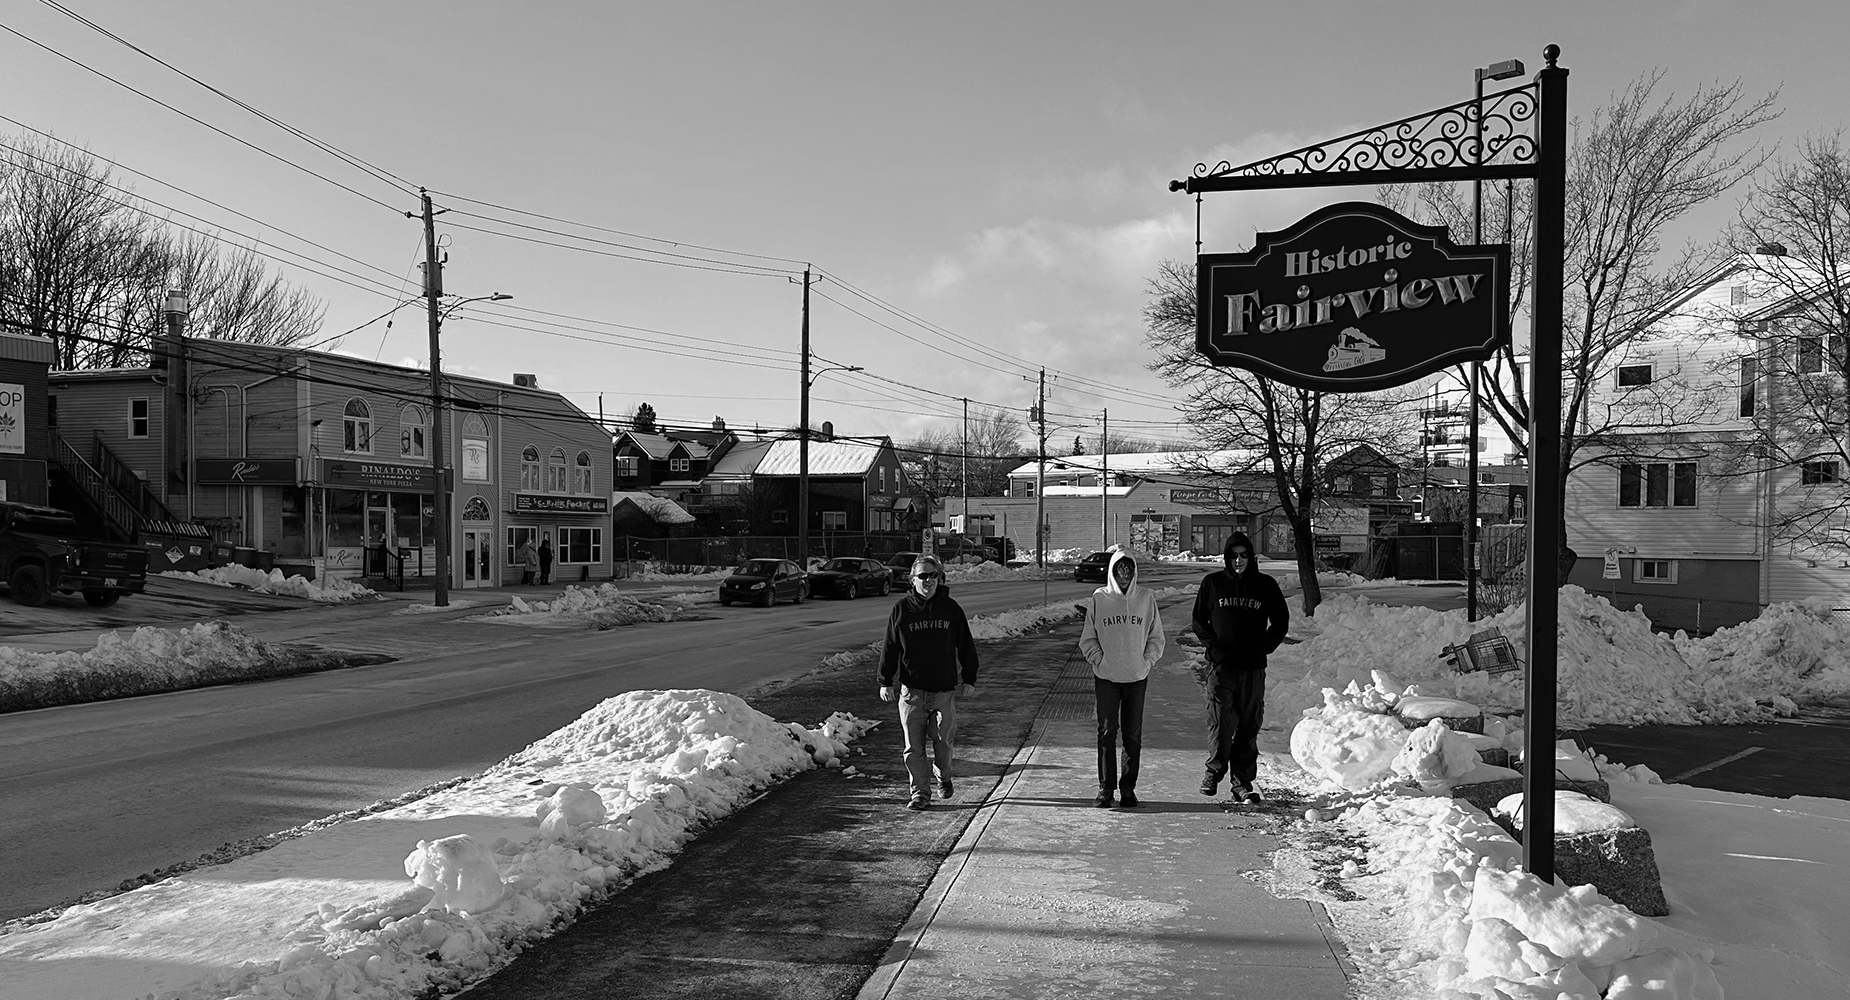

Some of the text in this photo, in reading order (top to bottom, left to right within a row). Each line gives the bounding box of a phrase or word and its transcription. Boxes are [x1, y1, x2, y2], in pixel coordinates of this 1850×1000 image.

[1284, 233, 1412, 279] Historic
[1222, 267, 1485, 338] Fairview
[360, 464, 421, 481] RINALDO'S
[369, 478, 383, 486] NEW
[397, 480, 413, 488] PIZZA
[1218, 597, 1262, 610] FAIRVIEW
[908, 619, 951, 632] FAIRVIEW
